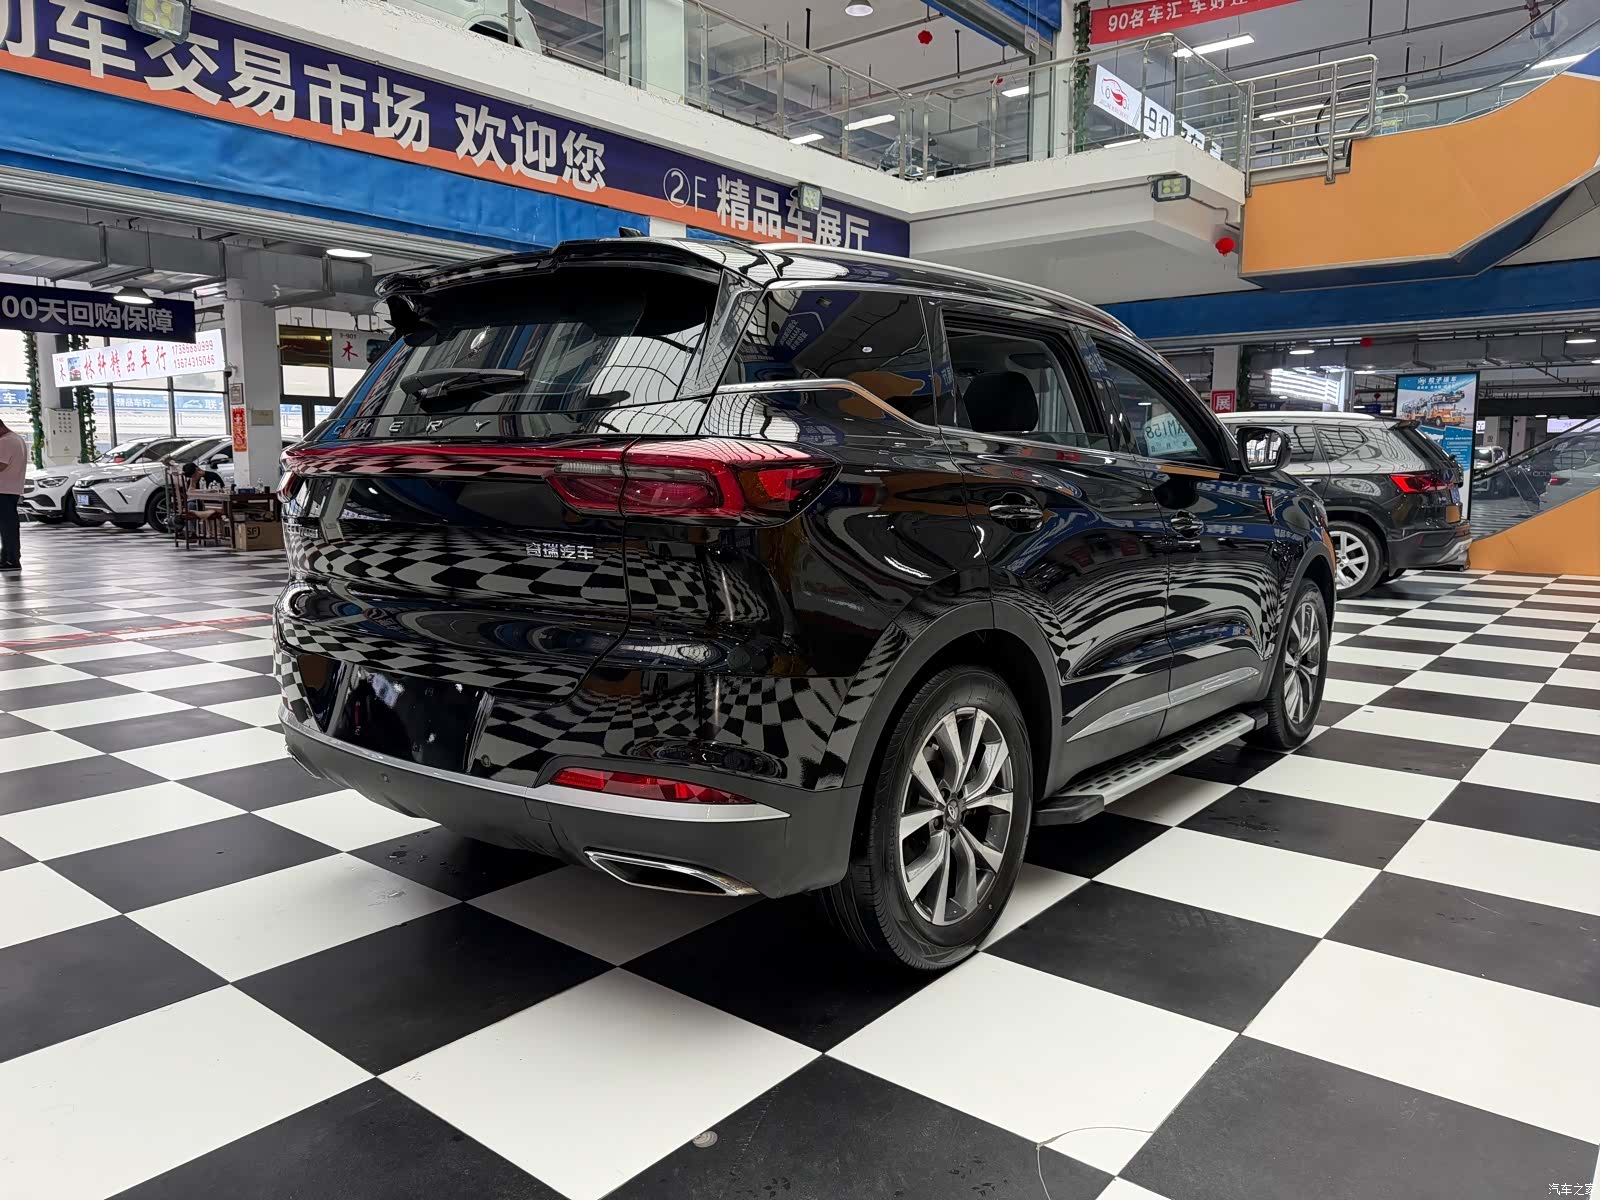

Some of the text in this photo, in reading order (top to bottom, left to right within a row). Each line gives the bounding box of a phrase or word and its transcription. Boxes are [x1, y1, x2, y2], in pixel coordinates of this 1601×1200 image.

[1108, 1, 1183, 32] 90名车汇
[455, 101, 606, 192] 欢迎您
[716, 173, 870, 250] 精品车展厅
[342, 340, 359, 361] 木
[1215, 395, 1231, 410] 展
[525, 542, 594, 560] 奇瑞汽车
